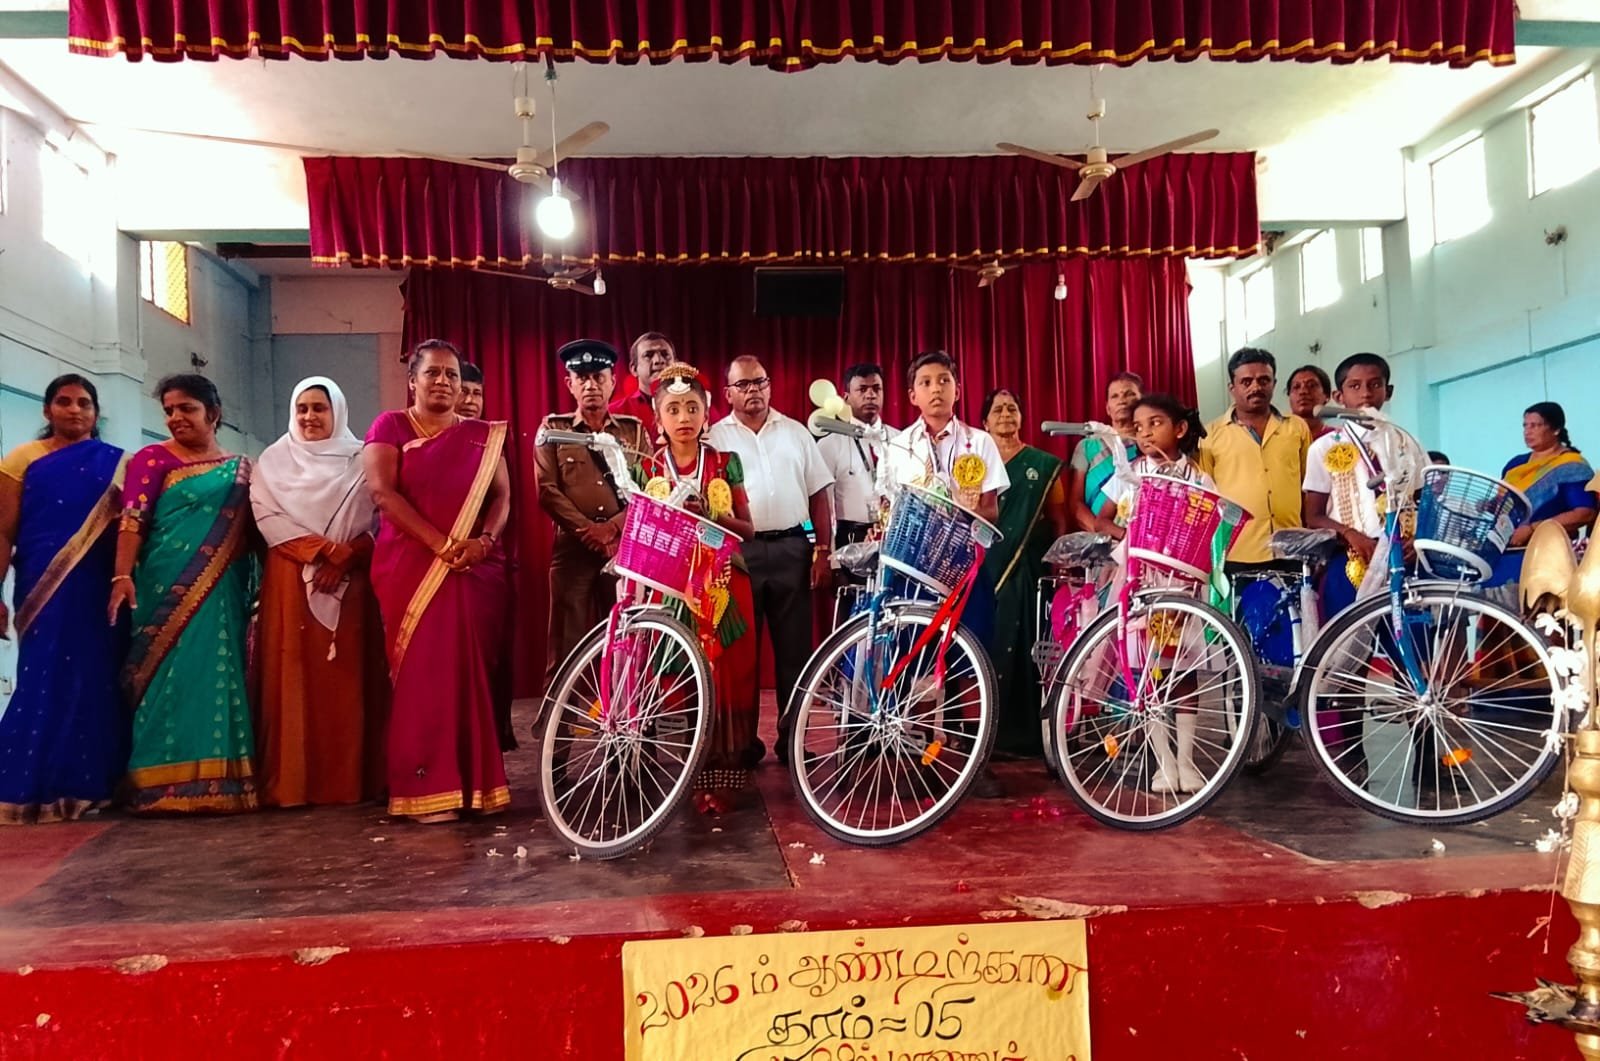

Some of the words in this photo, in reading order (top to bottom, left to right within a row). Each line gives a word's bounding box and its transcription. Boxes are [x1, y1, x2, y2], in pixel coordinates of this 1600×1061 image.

[635, 964, 740, 1040] 2026
[750, 953, 779, 996] ம்
[788, 932, 1088, 1005] ஆண்டிற்கான
